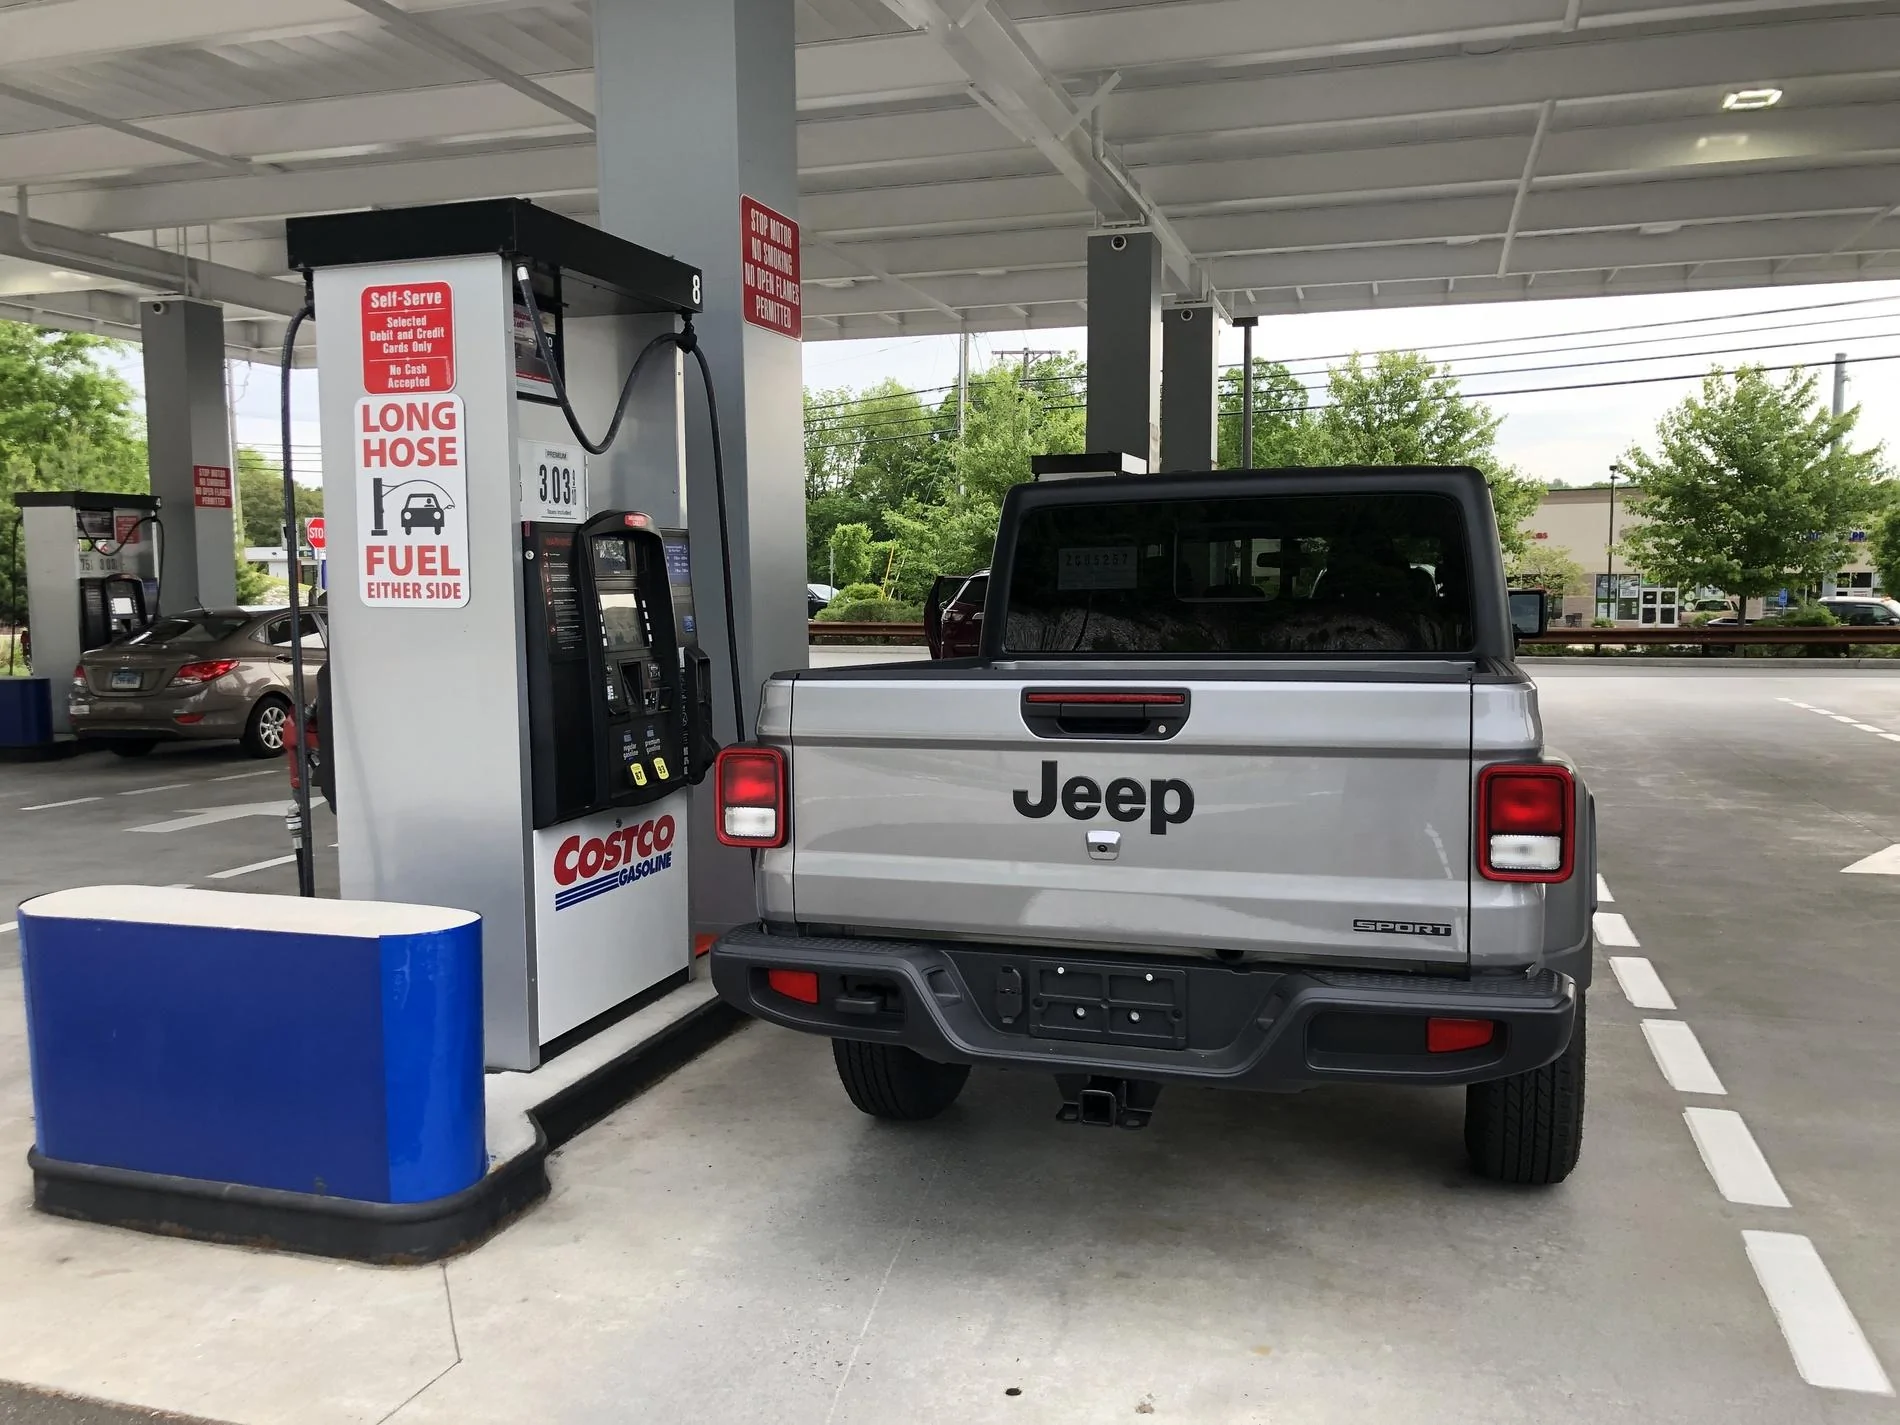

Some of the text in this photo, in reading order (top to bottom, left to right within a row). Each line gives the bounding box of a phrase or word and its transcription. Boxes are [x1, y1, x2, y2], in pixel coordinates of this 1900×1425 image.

[750, 208, 792, 249] STOP MOTOR
[751, 236, 793, 276] NO SMOKING
[371, 290, 442, 308] Self-Serve
[692, 274, 701, 305] 8
[744, 261, 800, 306] NO OPEN FLAMES
[387, 315, 427, 328] Selected
[756, 294, 792, 328] PERMITTED
[370, 327, 445, 341] Debit and Credit
[383, 341, 432, 353] Cards Only
[388, 376, 430, 389] Accepted
[389, 363, 427, 375] No Cash
[362, 401, 456, 433] LONG
[363, 436, 458, 468] HOSE
[539, 464, 570, 504] 3.03
[309, 527, 324, 539] STO
[366, 545, 461, 577] FUEL
[367, 582, 461, 599] EITHER SIDE
[657, 765, 666, 774] 93
[1012, 760, 1195, 835] Jeep
[553, 814, 676, 886] COSTCO
[619, 851, 672, 886] GASOLINE
[1353, 919, 1452, 936] SPORT
